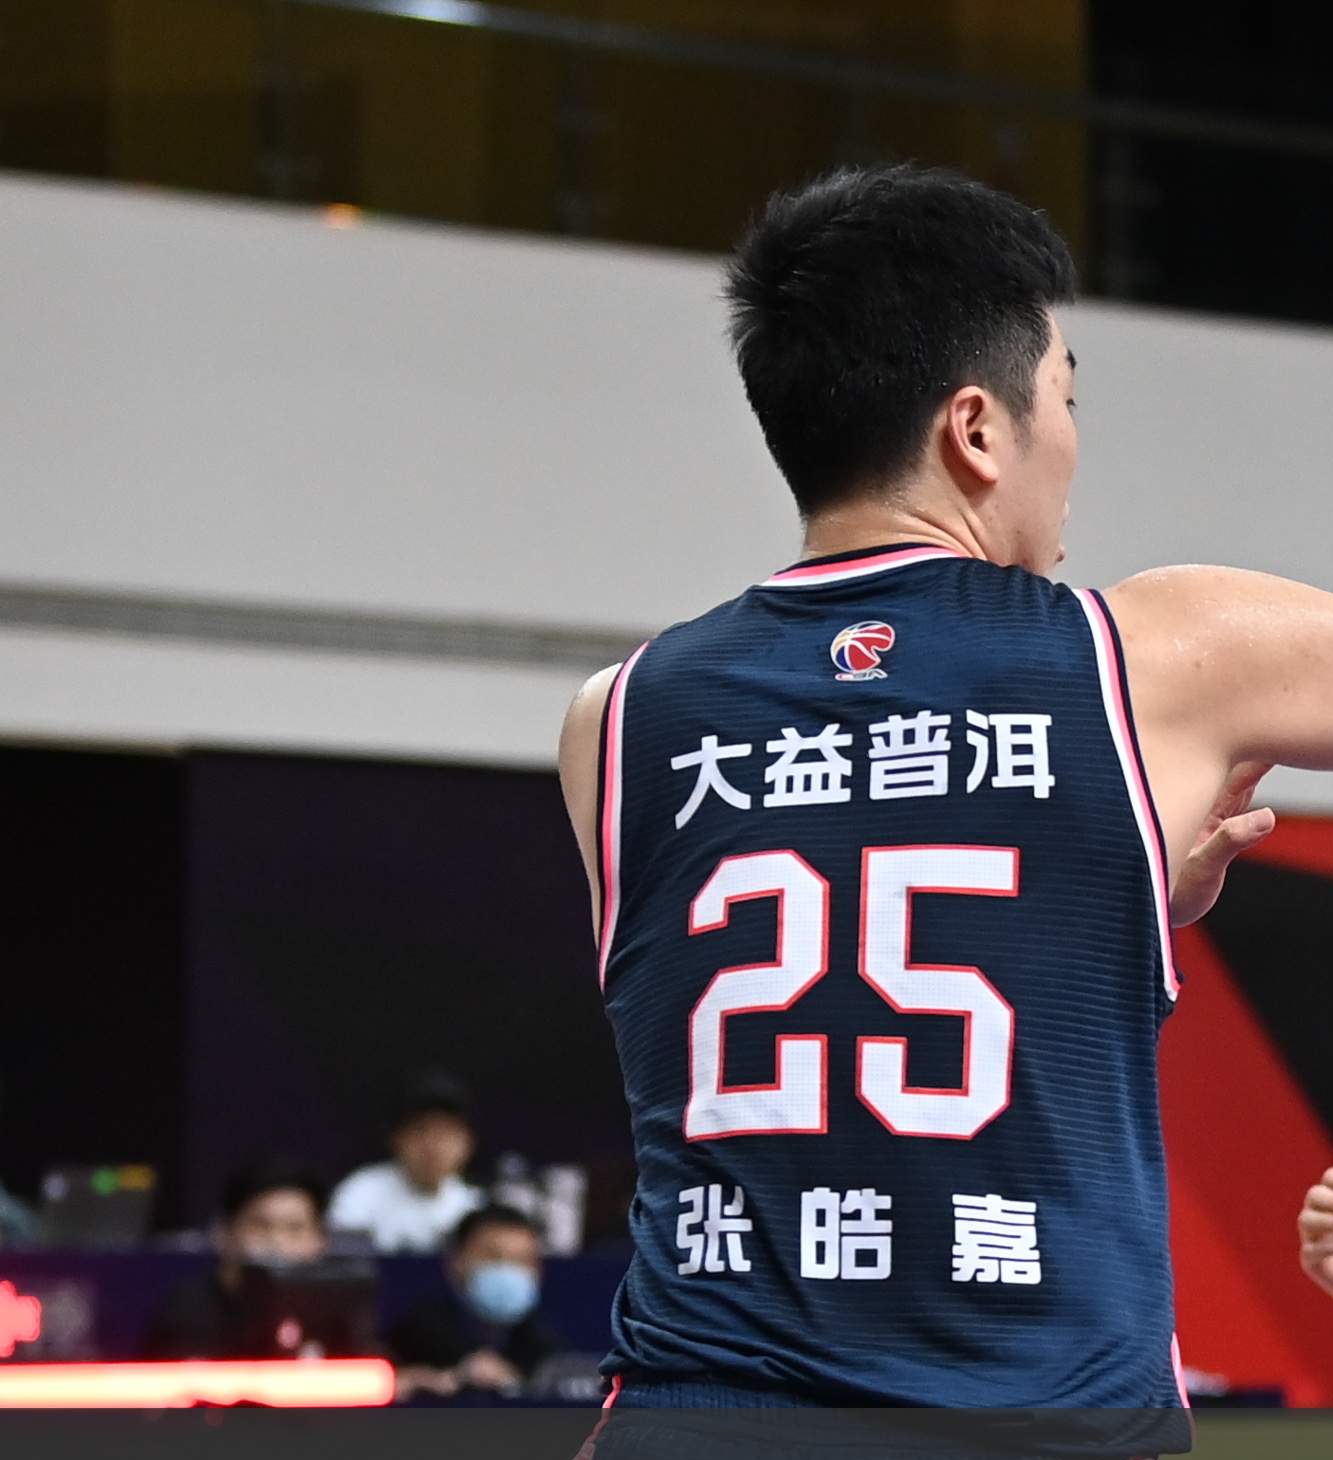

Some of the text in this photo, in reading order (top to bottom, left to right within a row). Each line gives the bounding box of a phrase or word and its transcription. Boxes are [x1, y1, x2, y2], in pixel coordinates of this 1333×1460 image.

[670, 710, 1055, 829] 大益普洱
[685, 845, 1019, 1141] 25
